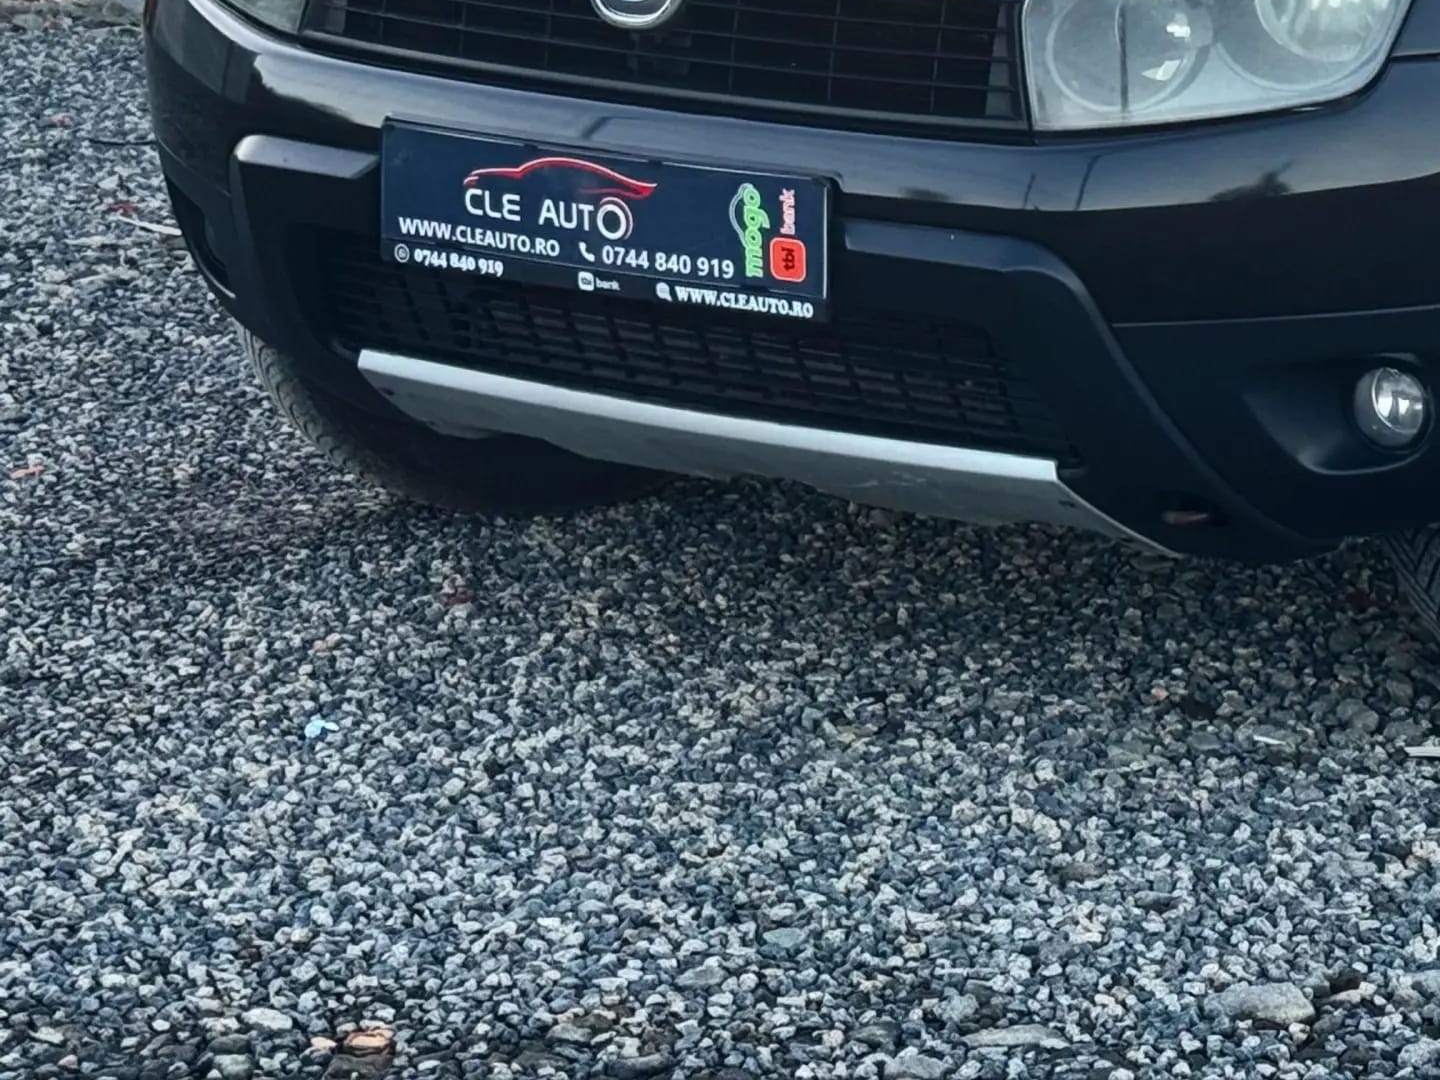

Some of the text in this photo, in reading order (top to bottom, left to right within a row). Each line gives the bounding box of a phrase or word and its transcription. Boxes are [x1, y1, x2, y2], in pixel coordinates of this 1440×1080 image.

[465, 188, 627, 241] CLE AUTO
[743, 186, 770, 278] mogo
[779, 188, 796, 236] bank
[398, 217, 560, 257] WWW.CLEAUTO.RO
[414, 248, 503, 277] 0744 840 919
[602, 244, 734, 279] 0744 840 919
[674, 285, 814, 318] WWW.CLEAUTO.RO
